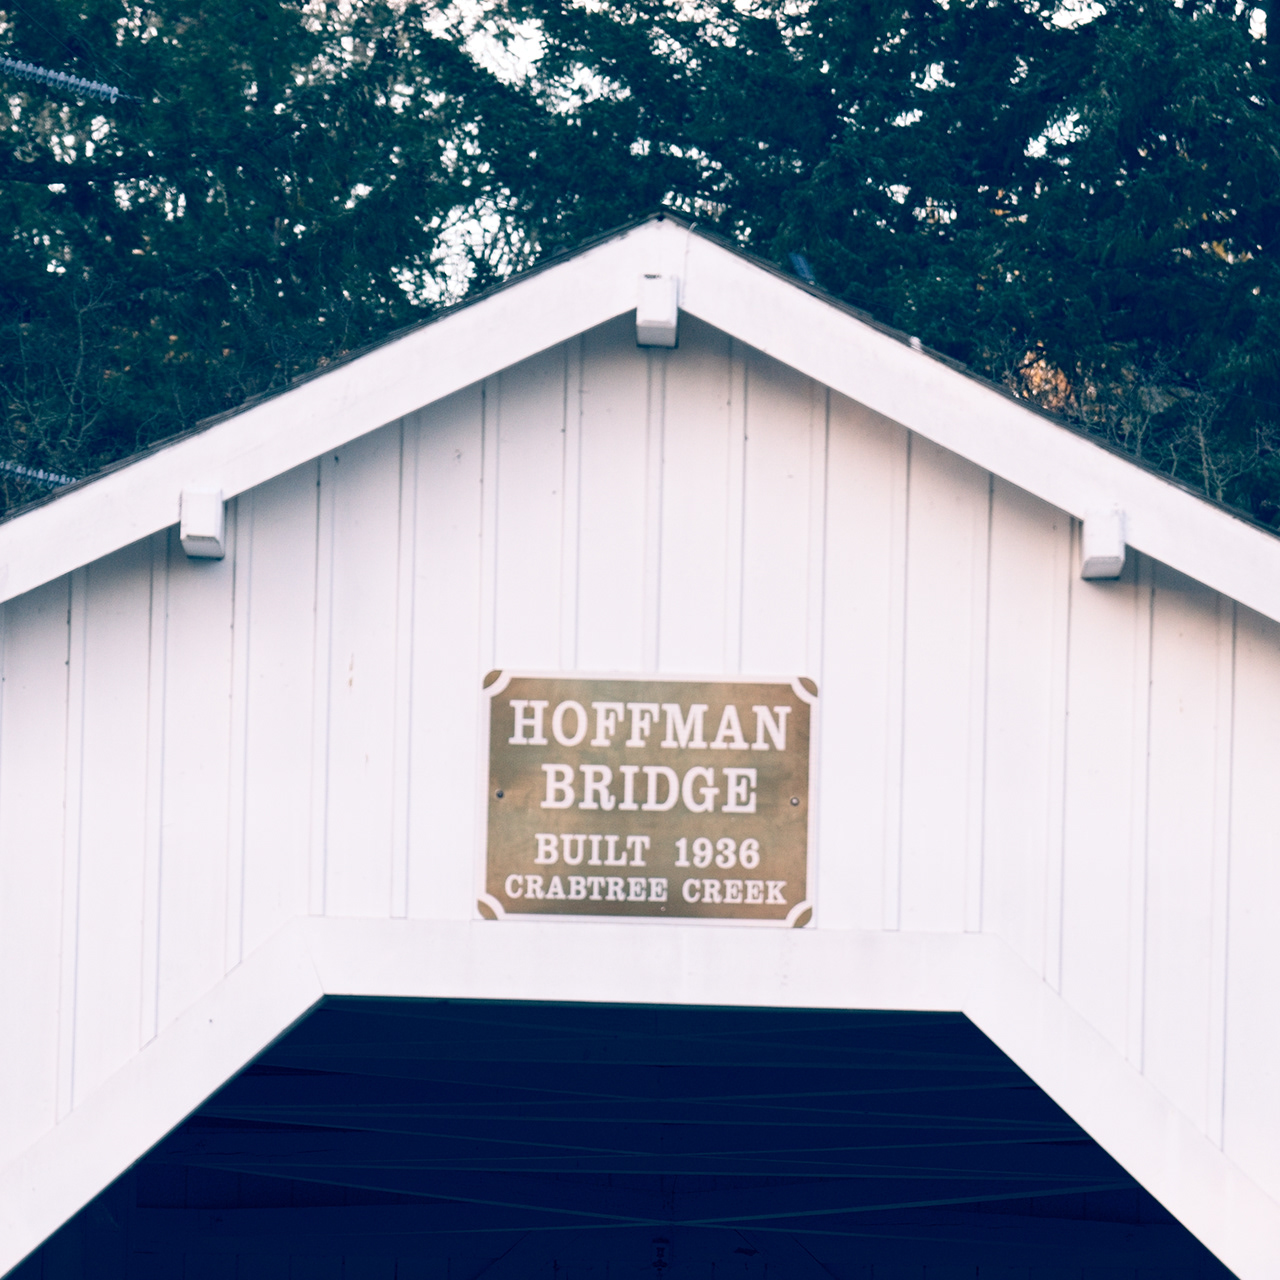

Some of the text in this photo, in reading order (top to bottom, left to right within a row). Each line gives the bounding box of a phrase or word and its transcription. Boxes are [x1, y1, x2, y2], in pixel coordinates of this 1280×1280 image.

[509, 700, 791, 750] HOFFMAN
[541, 764, 756, 813] BRIDGE
[534, 833, 759, 868] BUILT 1936
[505, 874, 786, 904] CRABTREE CREEK
